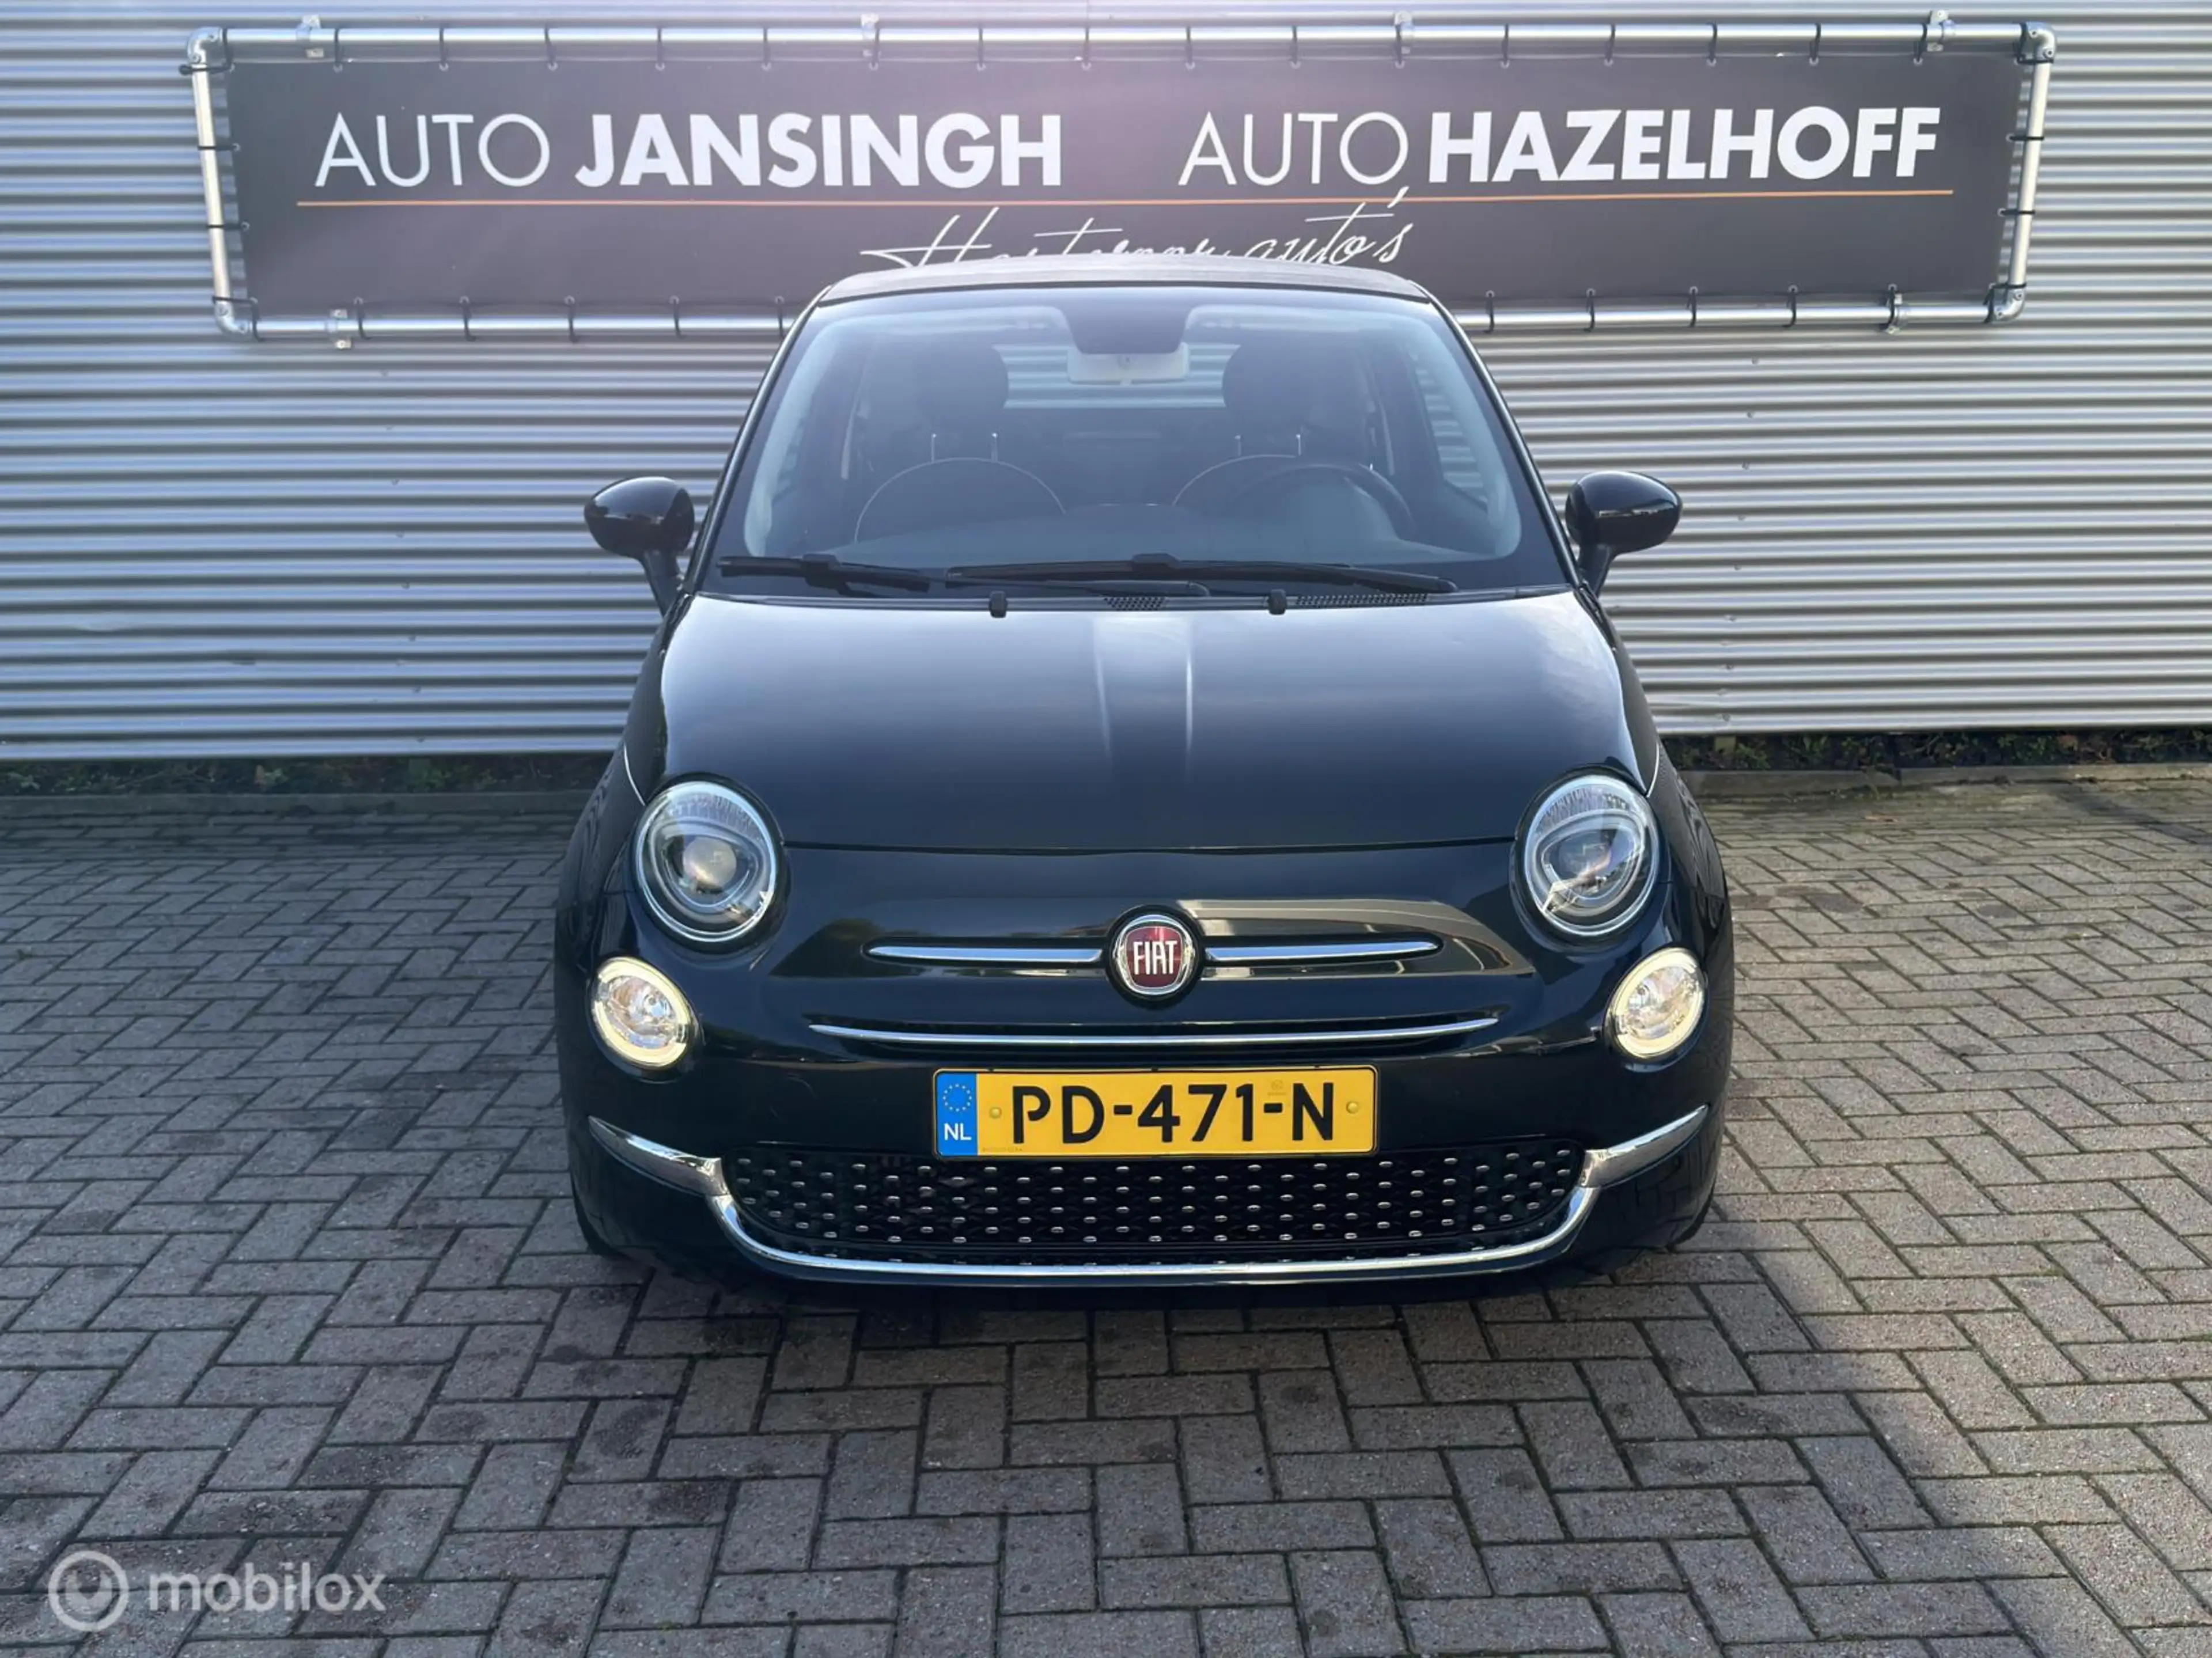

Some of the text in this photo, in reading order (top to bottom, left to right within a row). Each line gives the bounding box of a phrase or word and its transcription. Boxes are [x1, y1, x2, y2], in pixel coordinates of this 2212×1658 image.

[315, 105, 1941, 189] AUTO JANSINGH AUTO HAZELHOFF
[1133, 940, 1178, 976] FIAT
[944, 1122, 972, 1141] NL
[1012, 1082, 1334, 1144] PD-471-N
